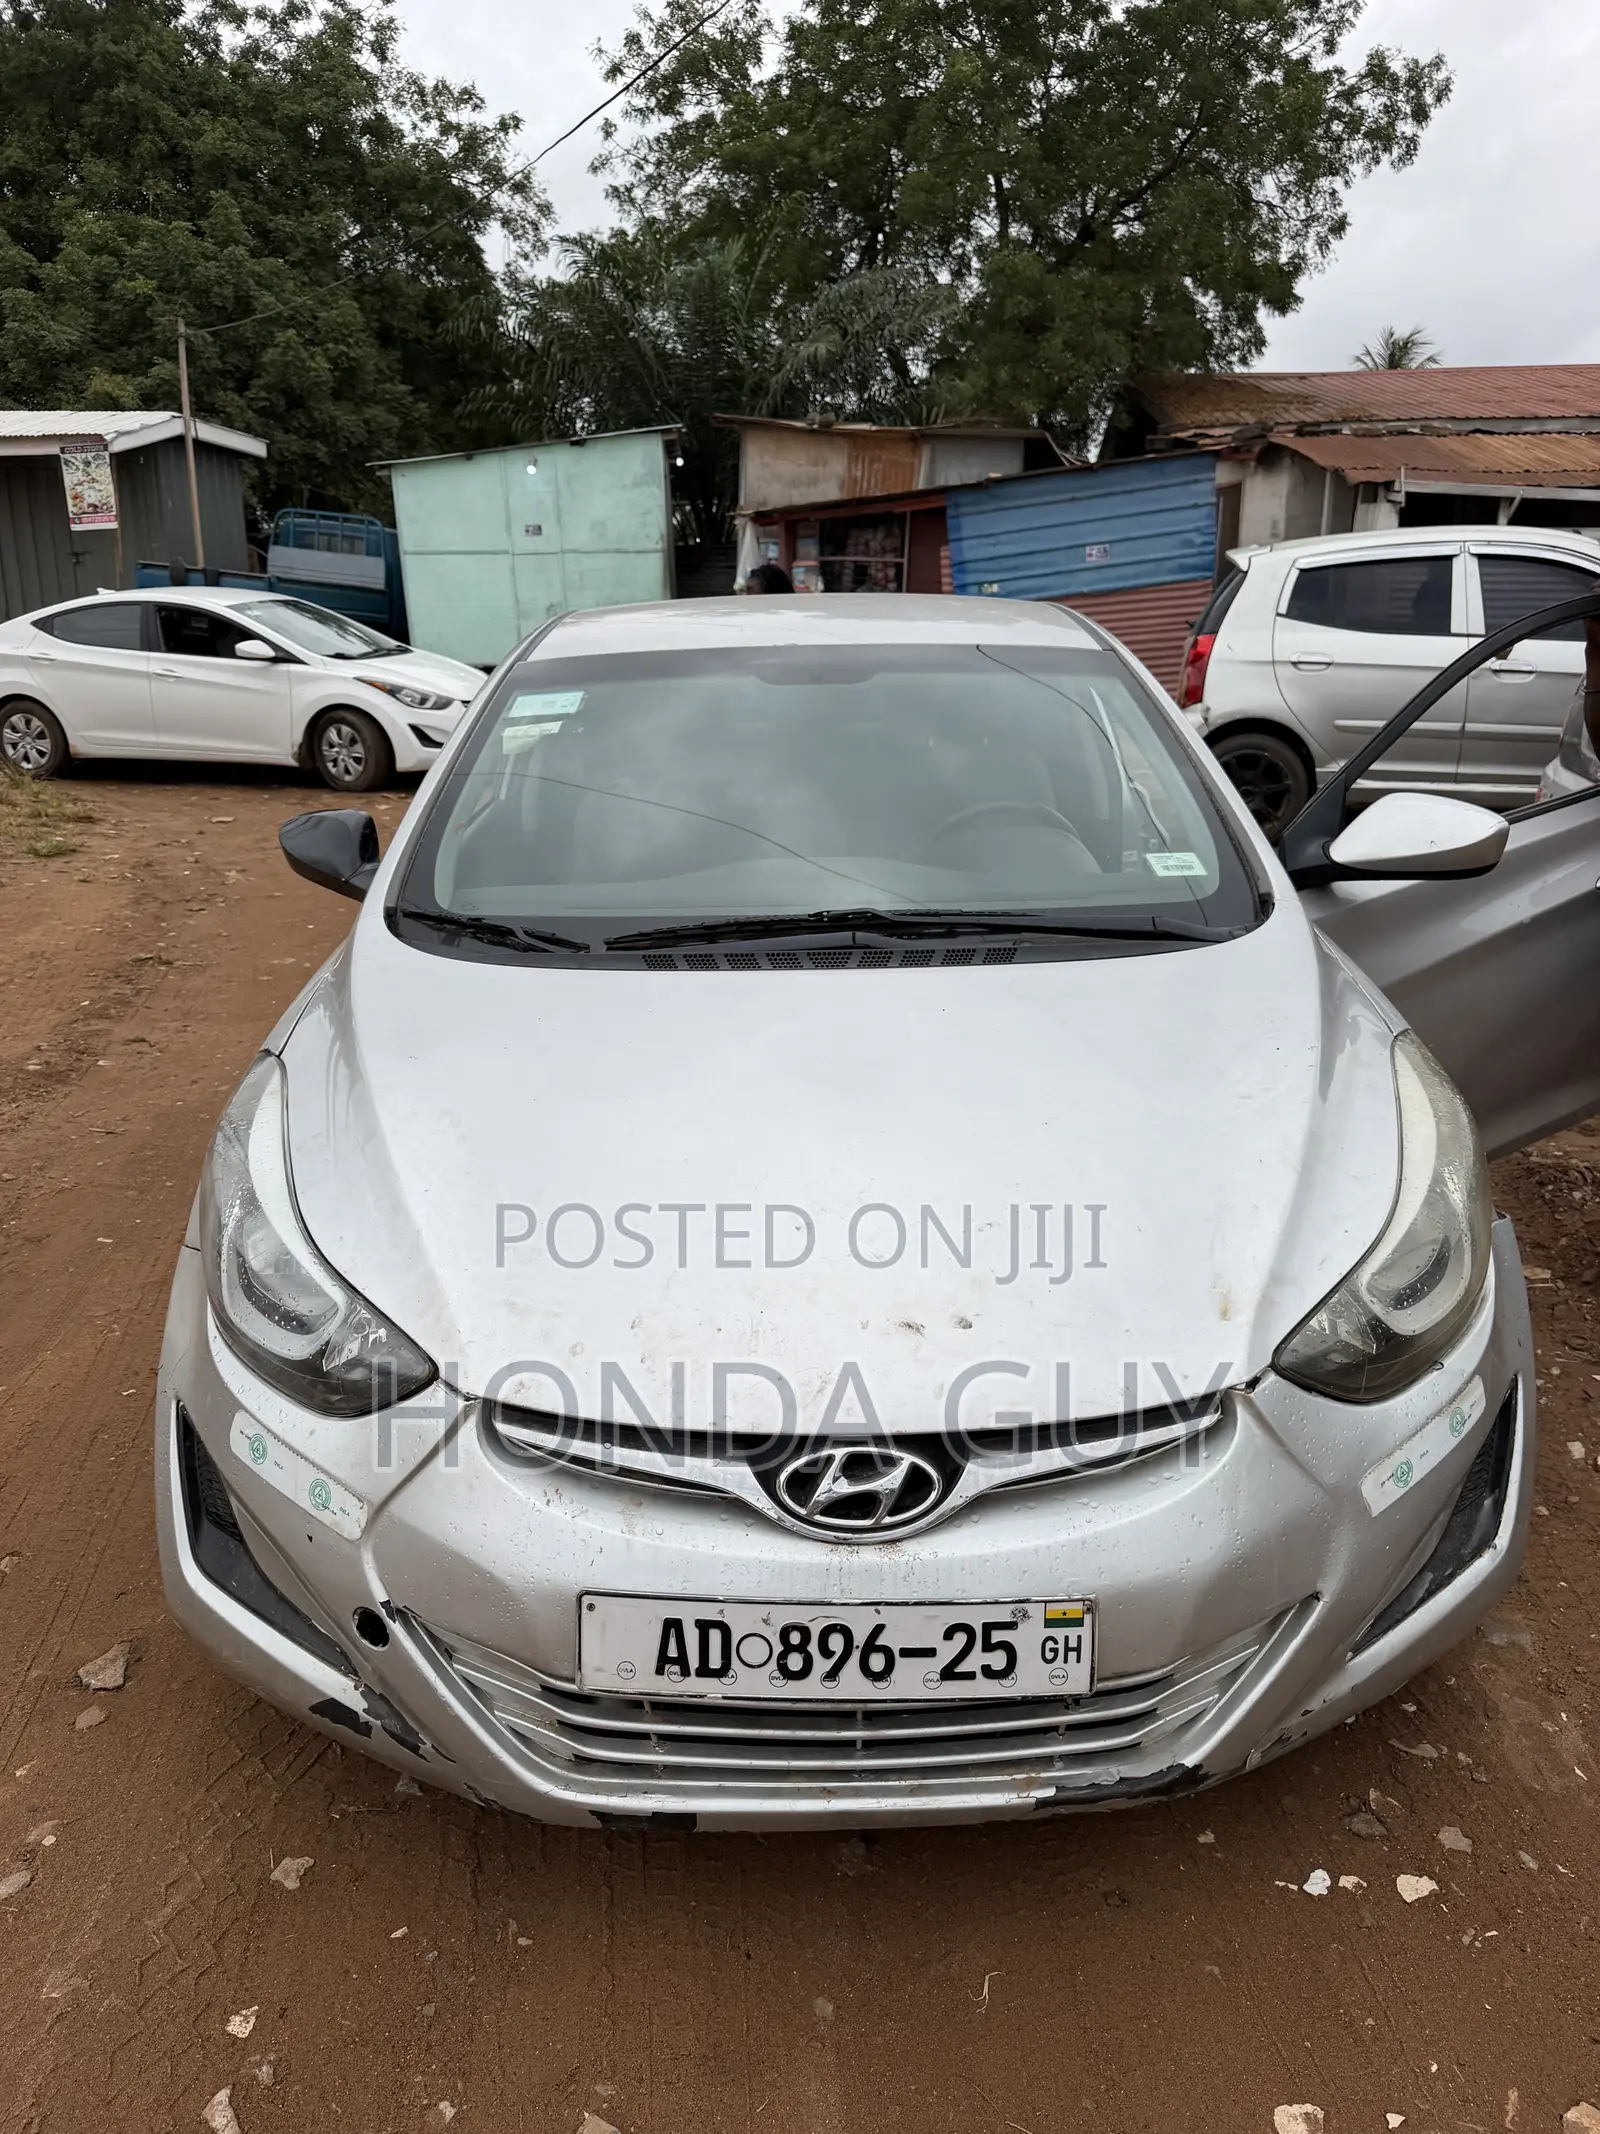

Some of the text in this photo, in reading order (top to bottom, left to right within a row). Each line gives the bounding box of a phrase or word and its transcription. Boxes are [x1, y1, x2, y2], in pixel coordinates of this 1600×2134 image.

[64, 446, 83, 454] COLD
[655, 1617, 1018, 1681] AD 896-25
[1041, 1634, 1082, 1665] GH
